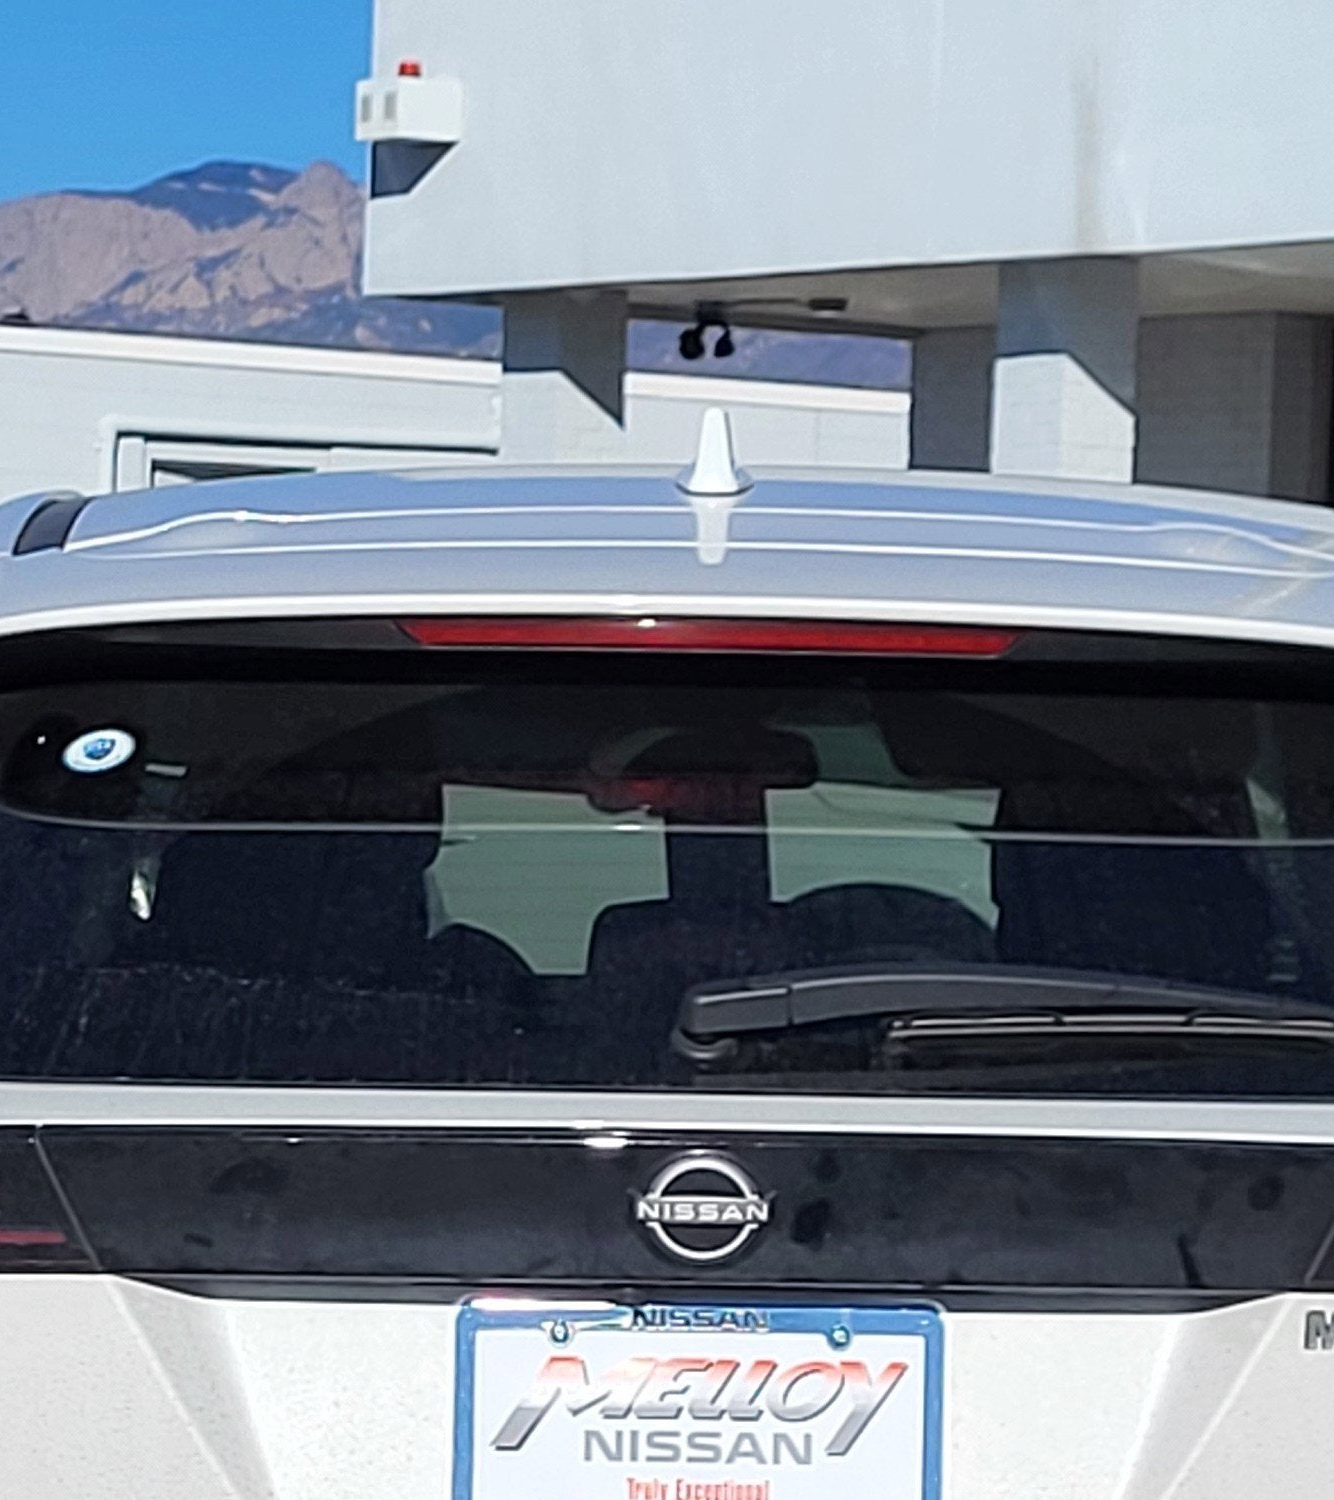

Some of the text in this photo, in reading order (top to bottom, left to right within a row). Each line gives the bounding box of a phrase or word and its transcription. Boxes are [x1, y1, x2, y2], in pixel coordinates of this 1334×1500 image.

[637, 1200, 768, 1222] NISSAN
[632, 1307, 768, 1331] NISSAN
[489, 1356, 909, 1457] MELLOY
[584, 1429, 813, 1465] NISSAN
